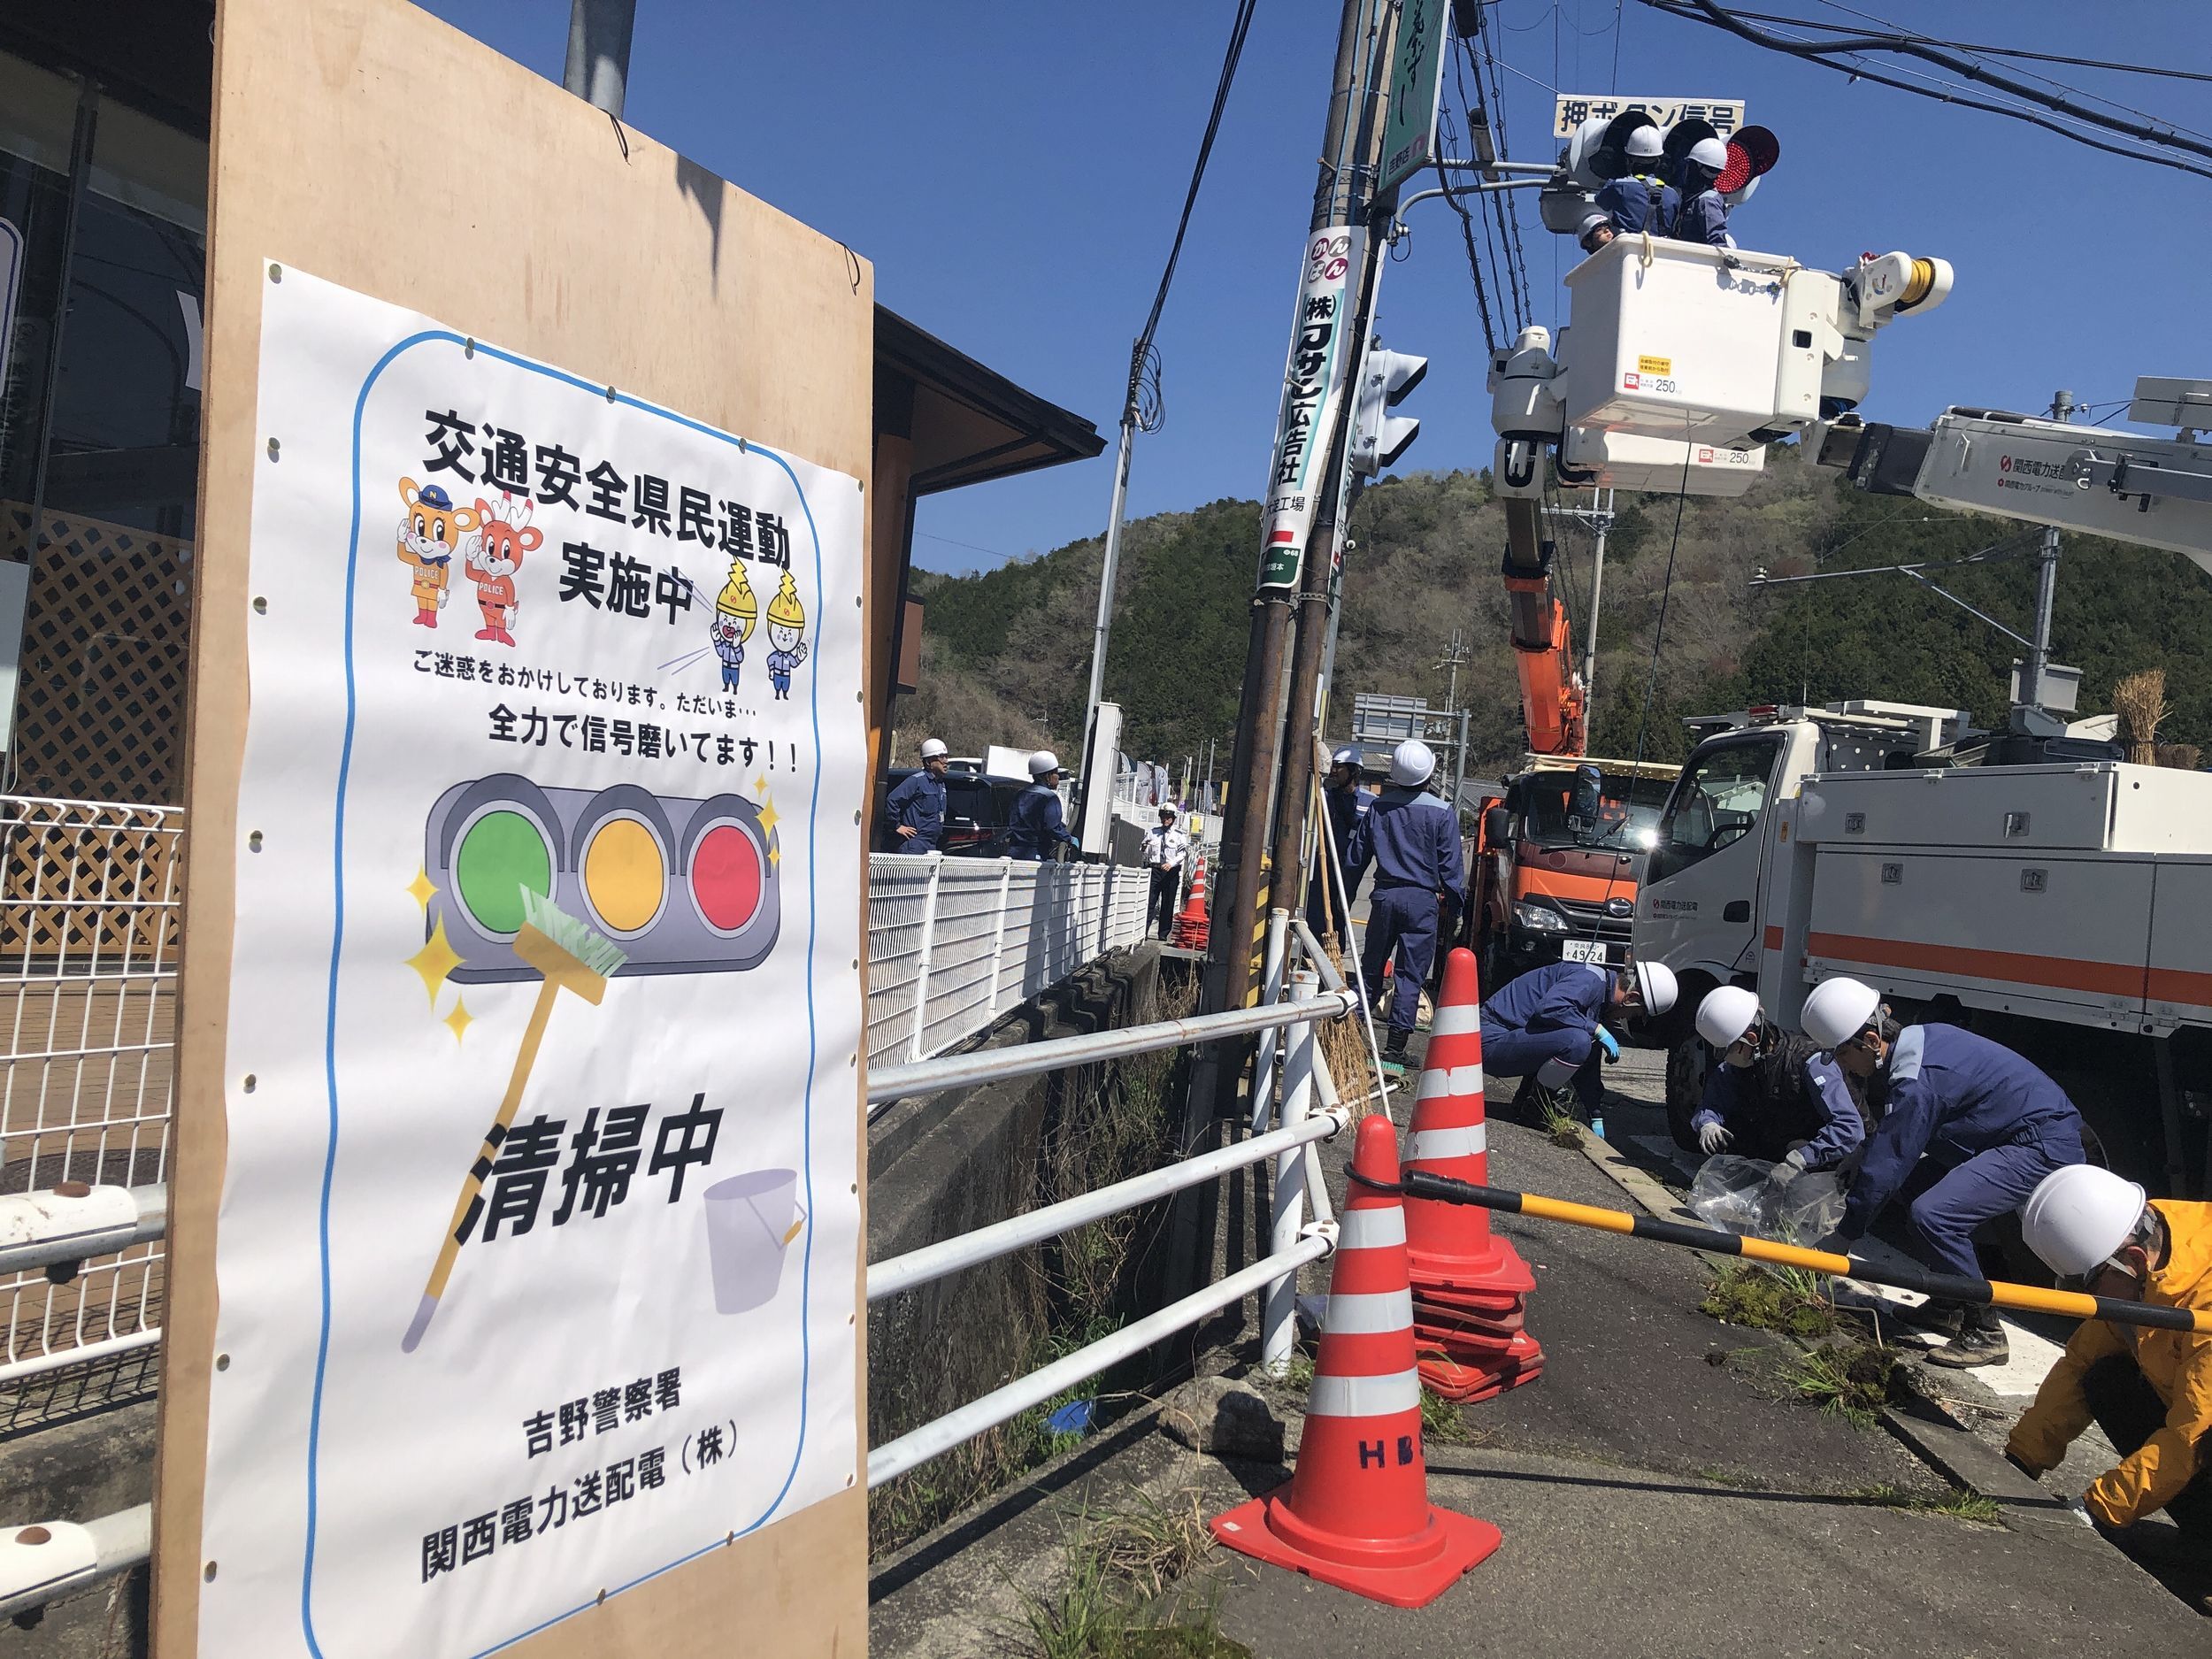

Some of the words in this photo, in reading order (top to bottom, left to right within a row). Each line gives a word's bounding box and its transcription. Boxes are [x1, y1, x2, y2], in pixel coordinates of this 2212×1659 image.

[1388, 145, 1410, 176] 吉野店
[1656, 379, 1676, 393] 250
[1730, 452, 1749, 465] 250
[422, 409, 791, 569] 交通安全県民運動
[414, 566, 439, 580] POLICE
[559, 541, 694, 626] 実施中
[479, 583, 503, 595] POLICE
[1572, 949, 1603, 963] 4924
[454, 1093, 724, 1246] 清掃中
[522, 1366, 682, 1459] 吉野警察署
